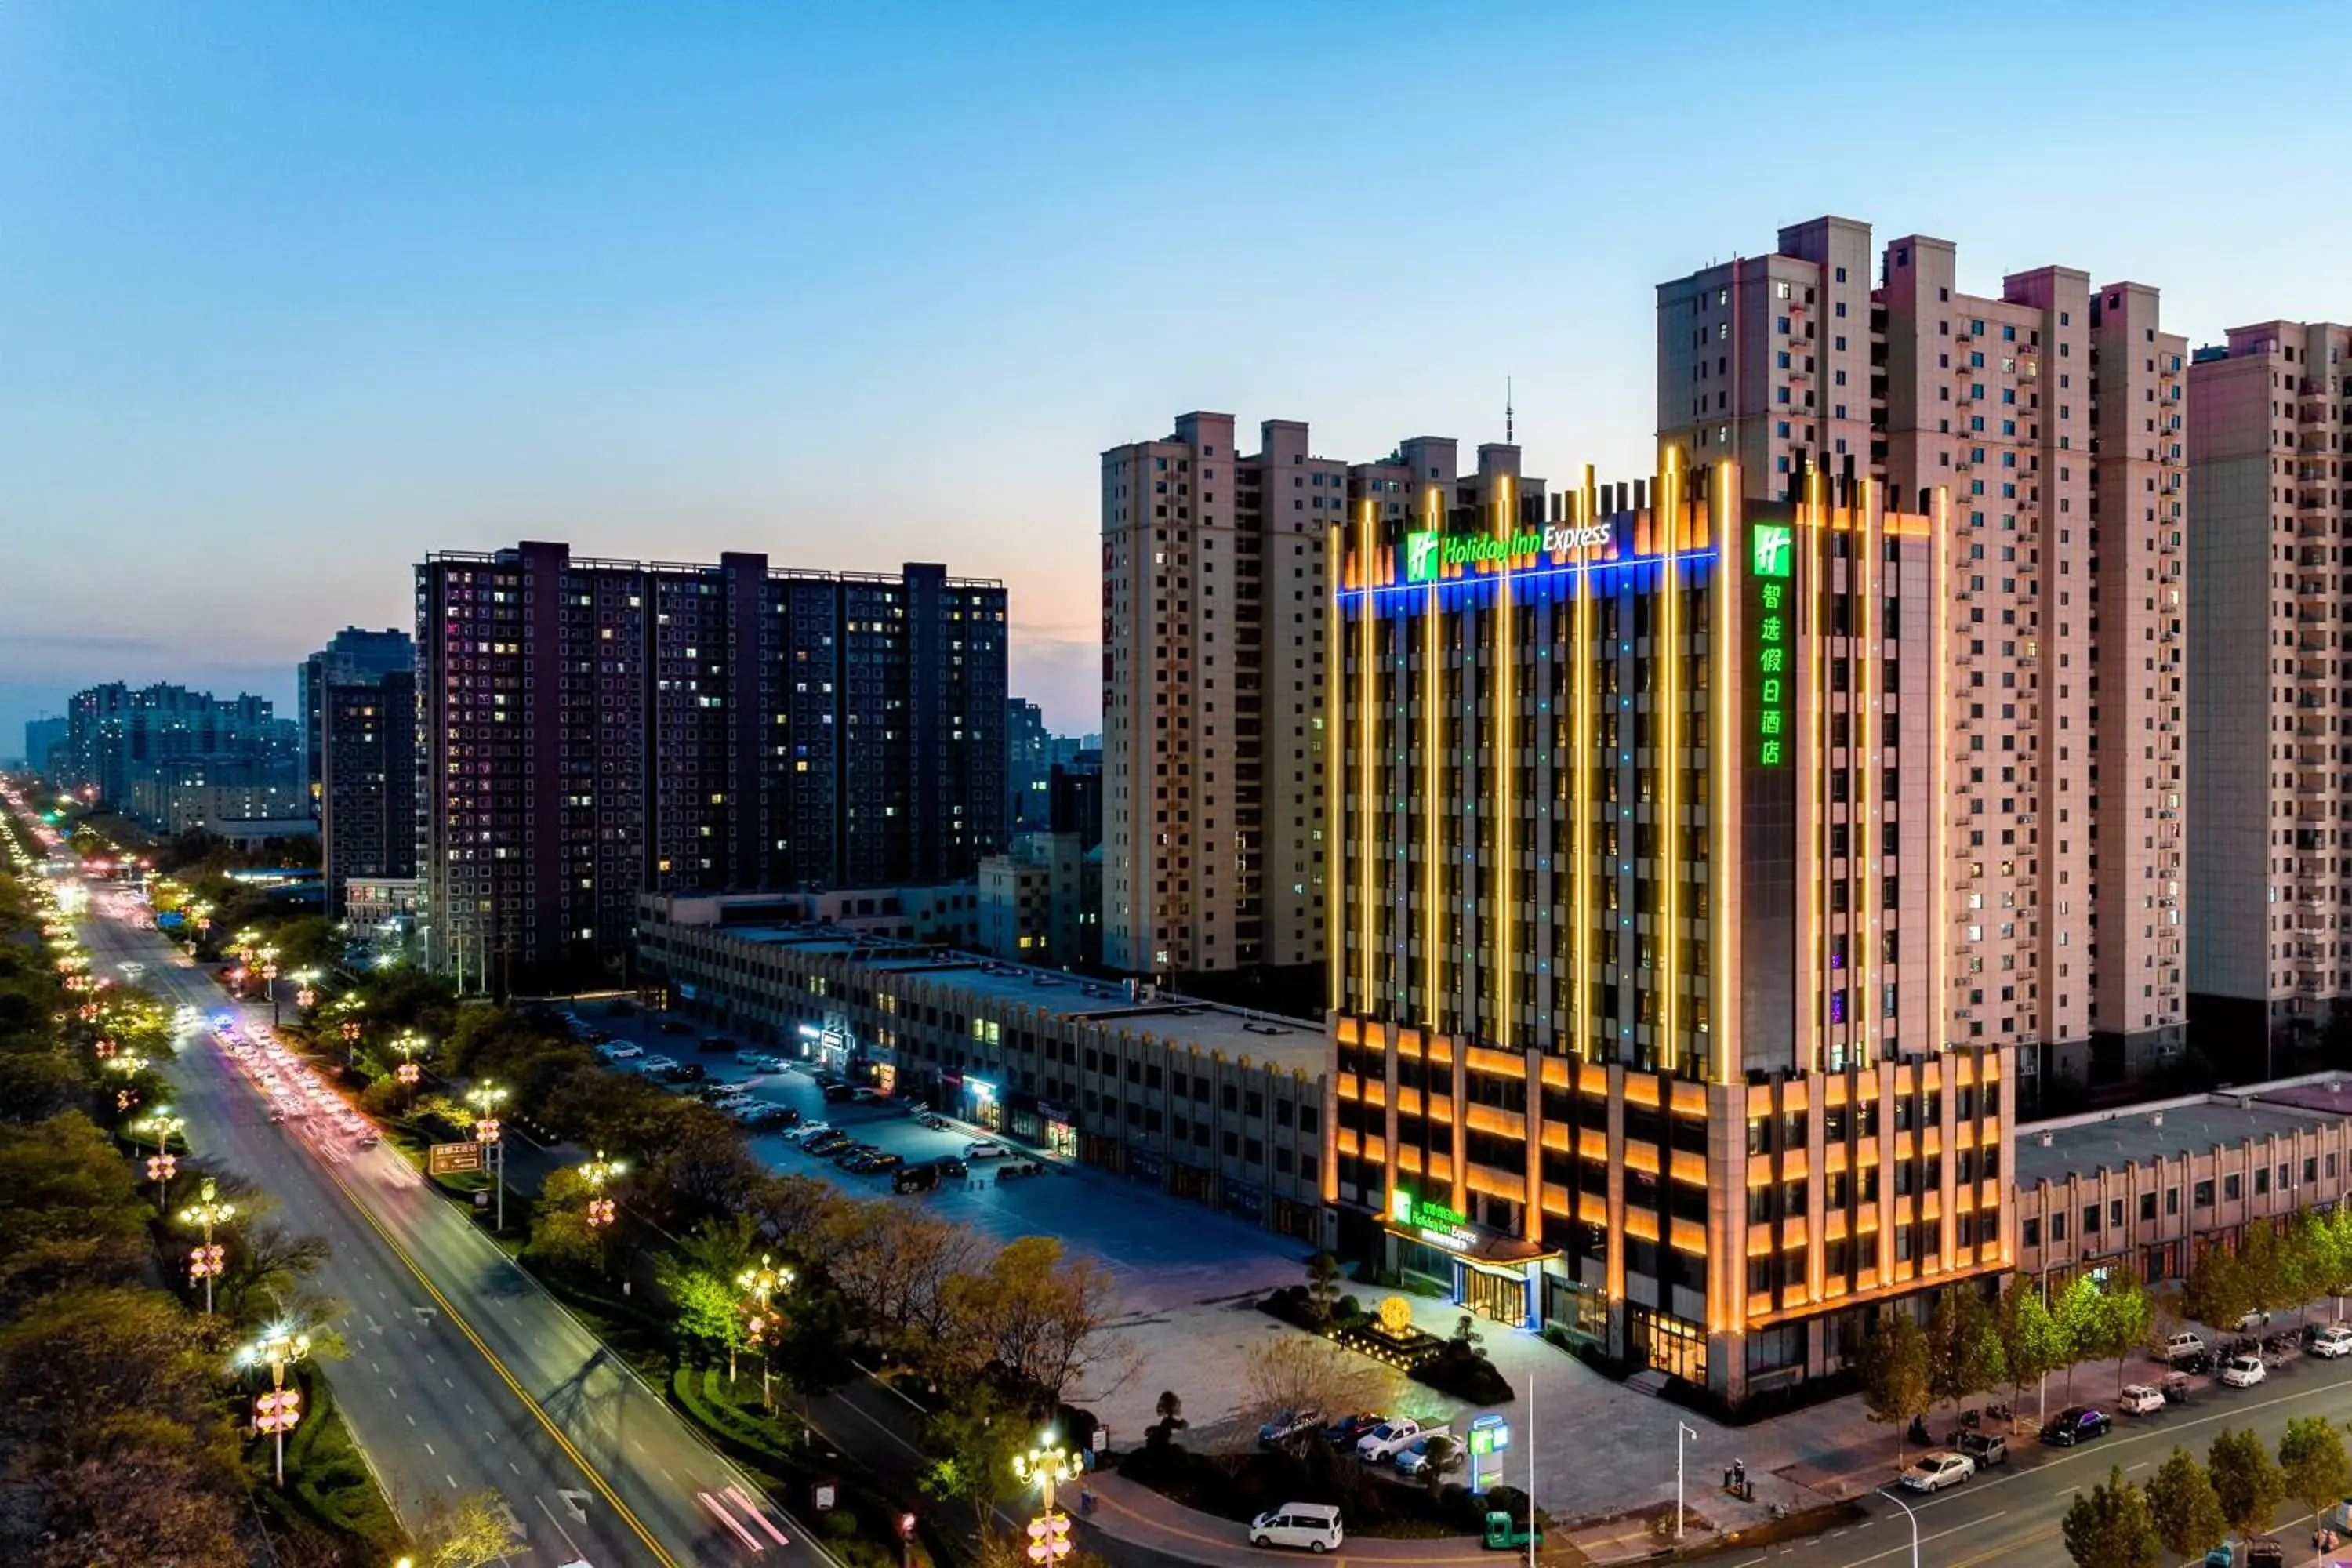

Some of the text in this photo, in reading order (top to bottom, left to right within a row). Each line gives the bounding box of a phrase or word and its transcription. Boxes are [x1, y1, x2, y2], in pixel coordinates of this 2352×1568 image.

[1442, 522, 1611, 563] Holiday Inn Express
[1761, 583, 1782, 765] 智选假日酒店
